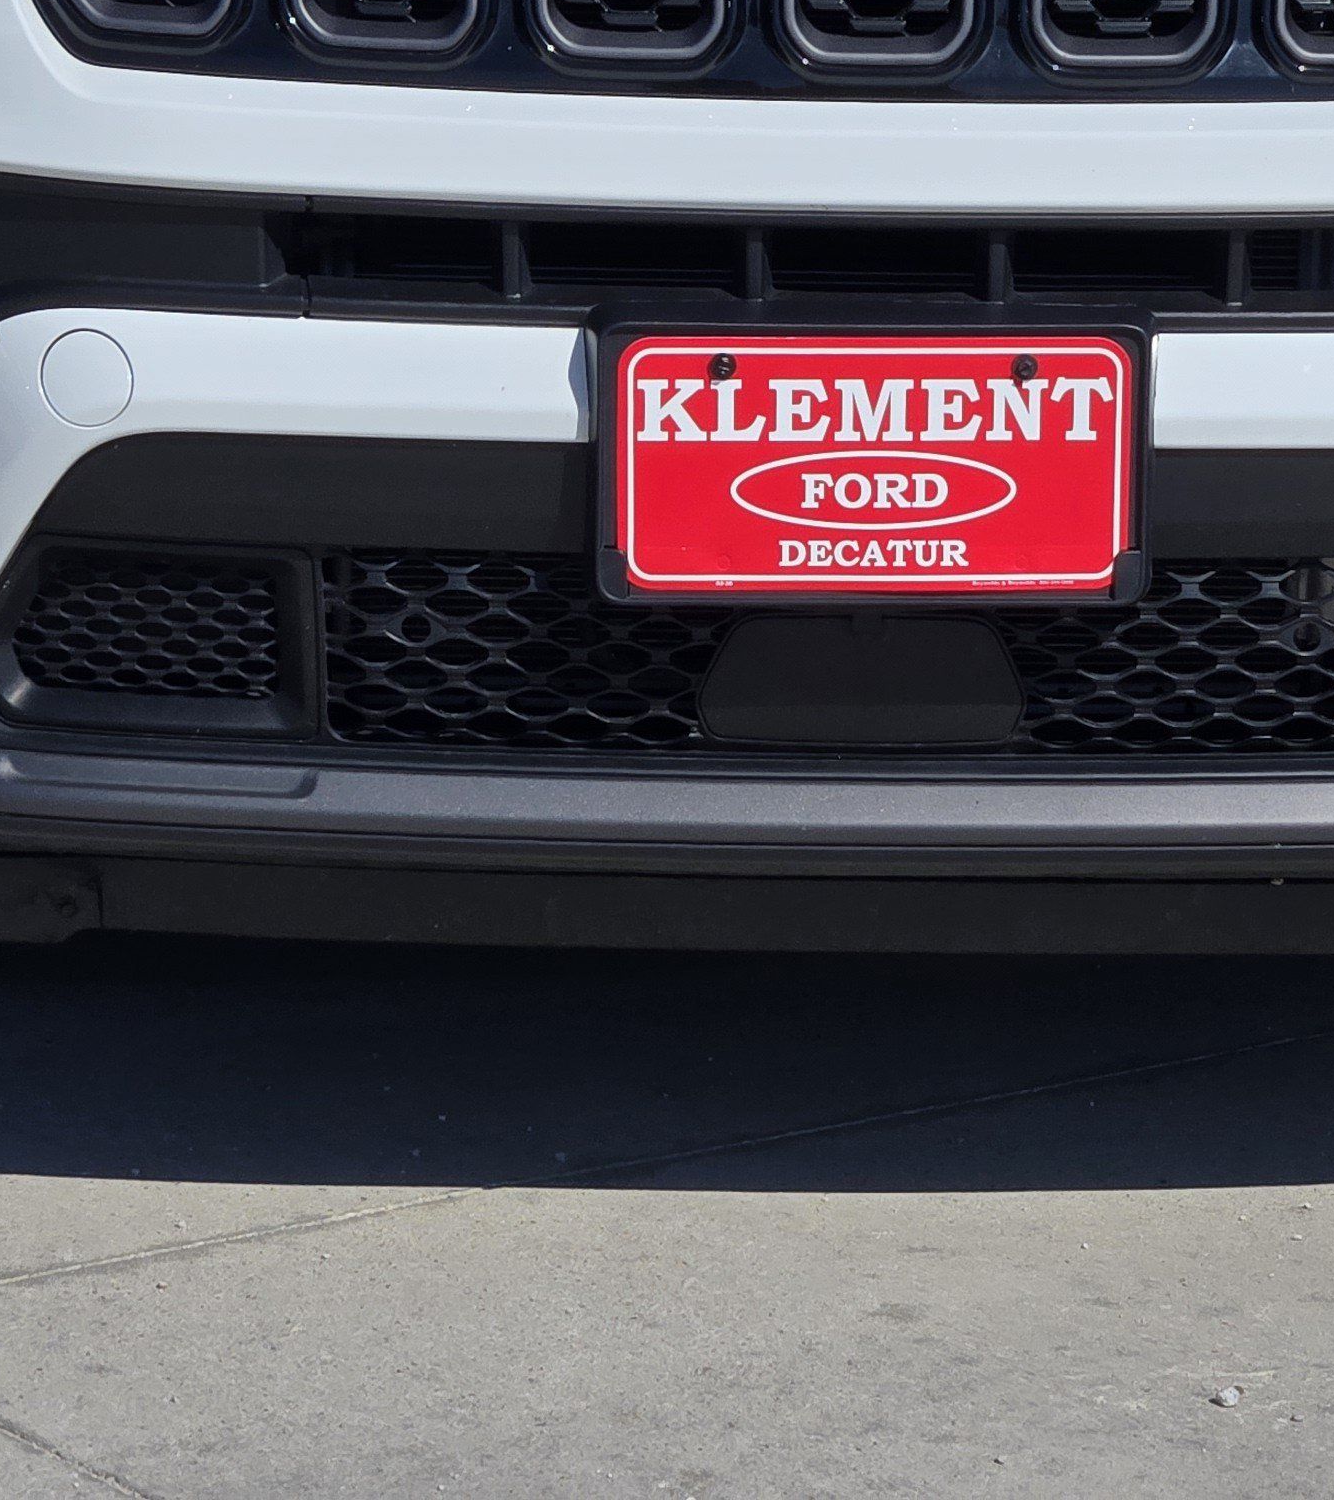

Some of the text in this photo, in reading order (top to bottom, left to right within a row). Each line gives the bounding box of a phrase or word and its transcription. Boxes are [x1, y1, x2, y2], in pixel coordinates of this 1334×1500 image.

[636, 376, 1114, 442] KLEMENT
[800, 473, 949, 509] FORD
[778, 540, 969, 567] DECATUR
